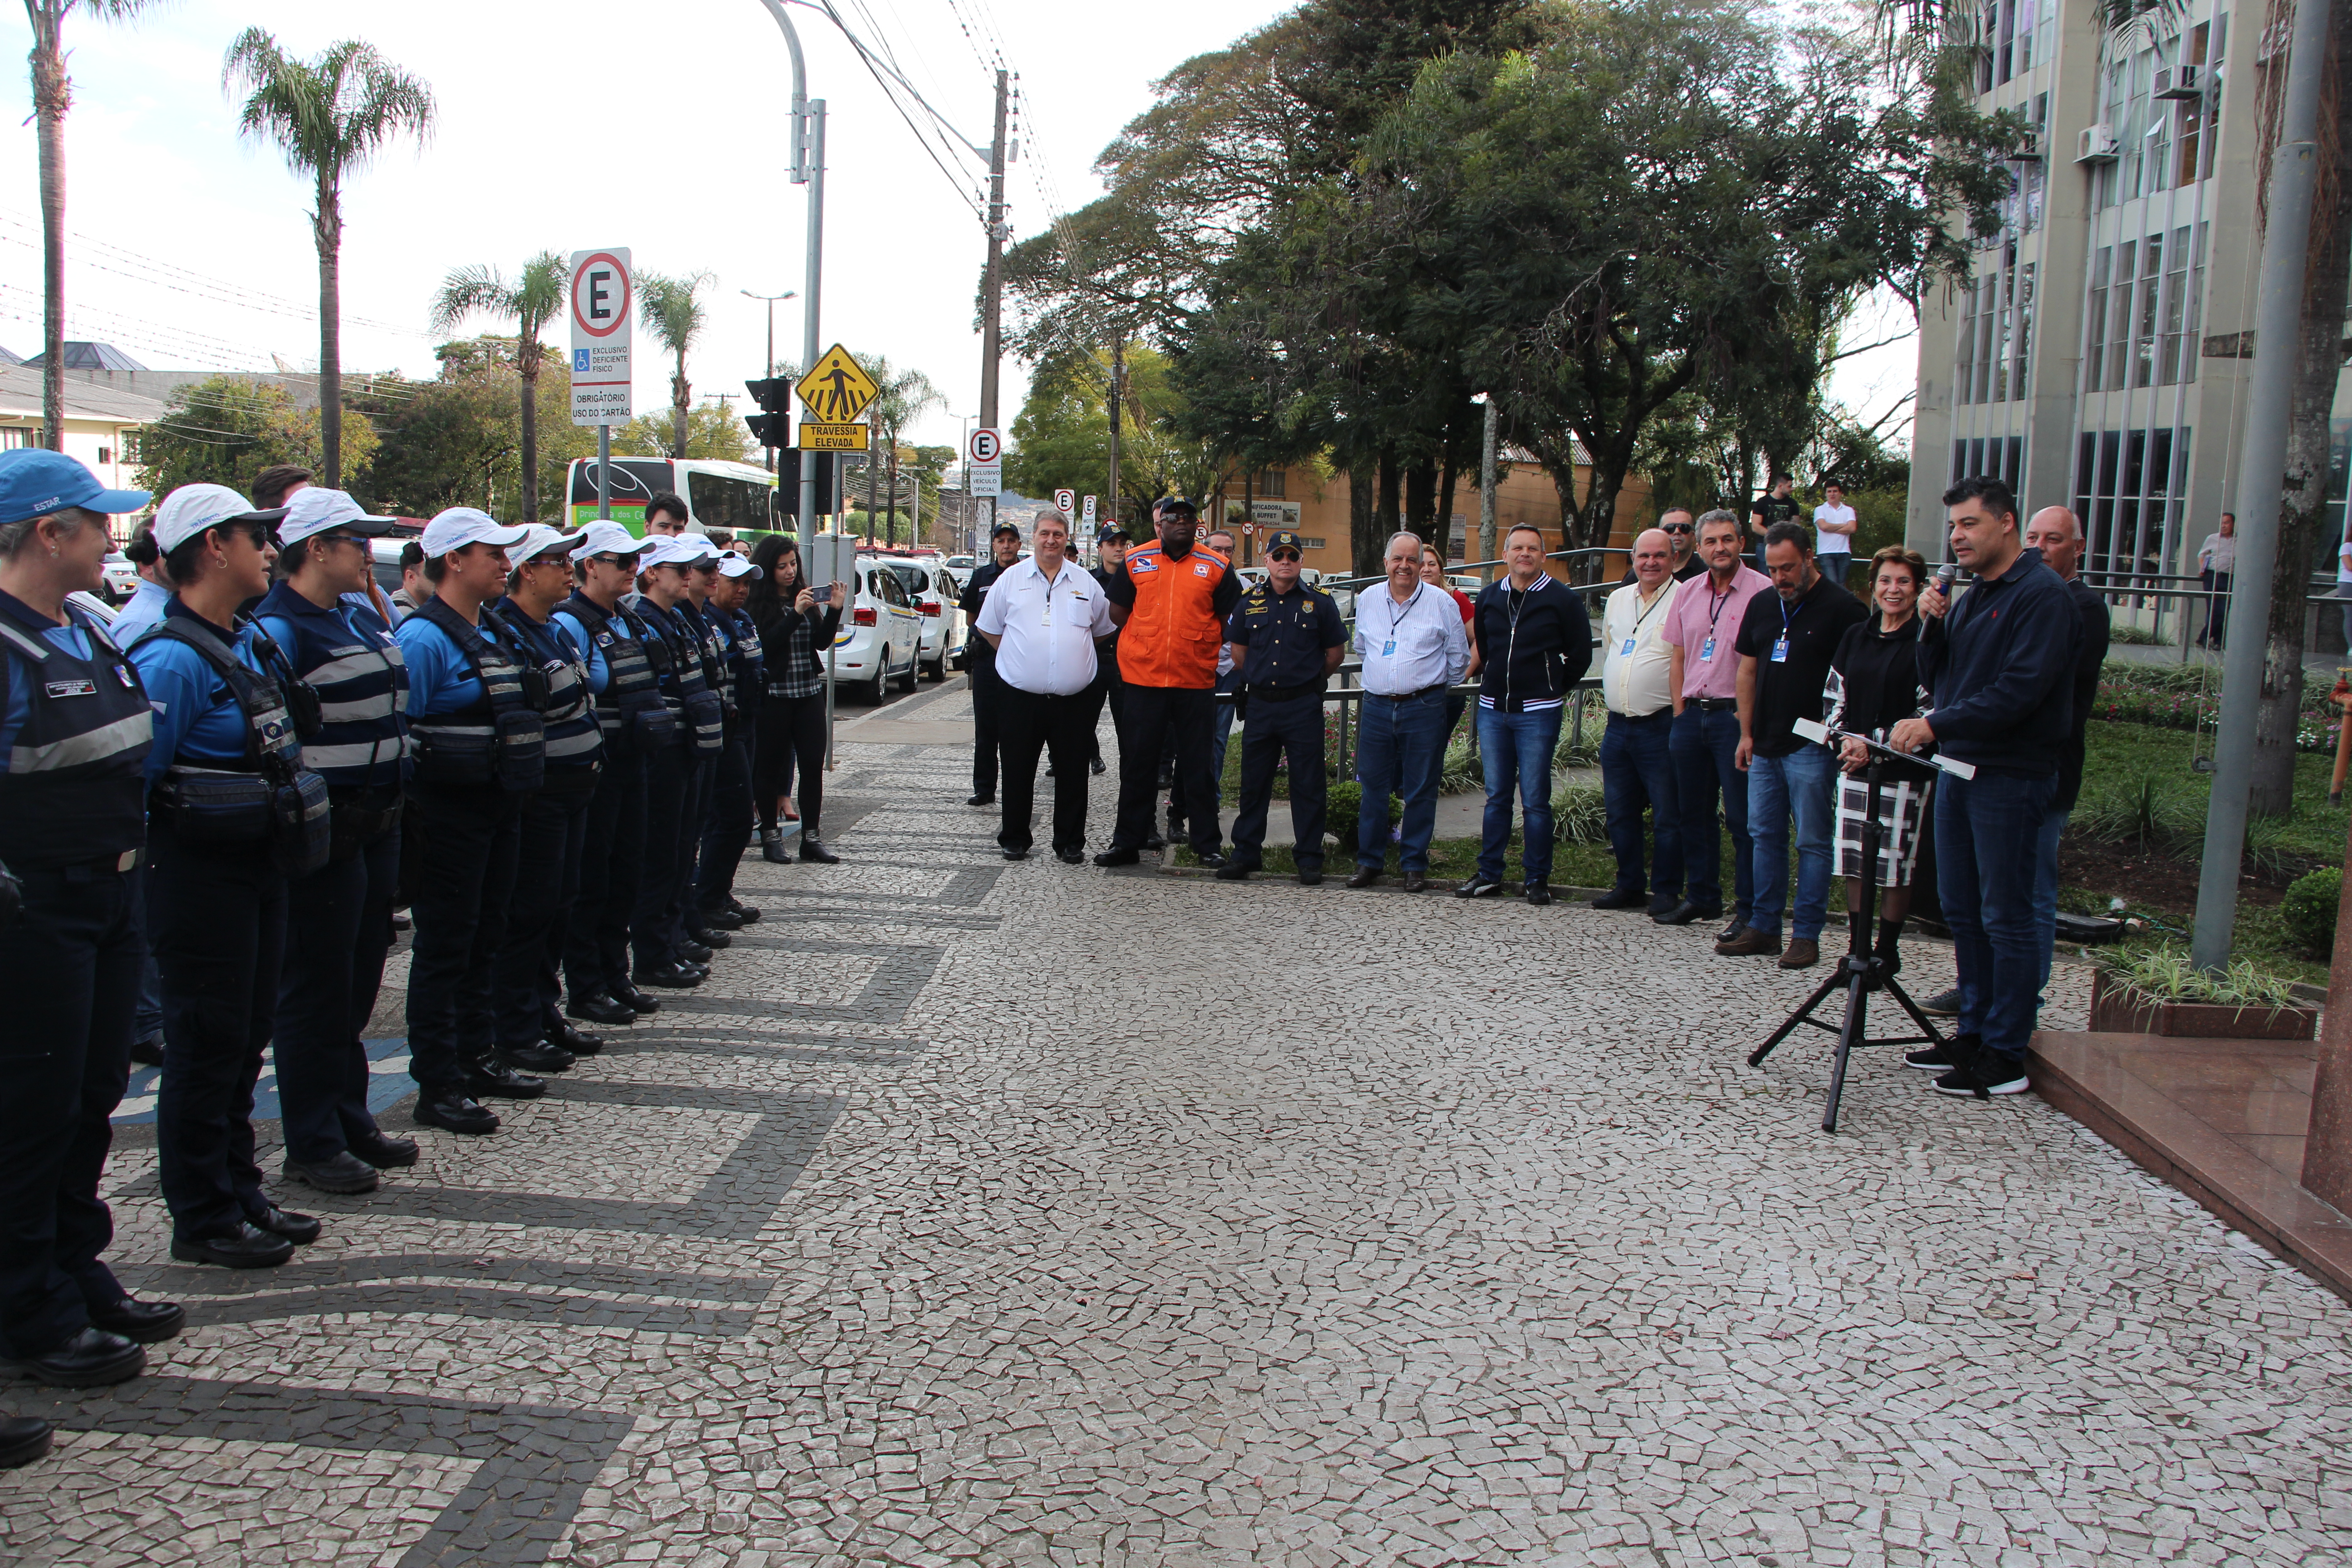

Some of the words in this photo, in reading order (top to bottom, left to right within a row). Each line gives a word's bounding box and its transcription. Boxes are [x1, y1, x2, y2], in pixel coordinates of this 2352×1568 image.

[590, 271, 610, 319] E
[593, 346, 627, 354] EXCLUSIVO
[593, 355, 628, 363] DEFICIENTE
[593, 364, 612, 372] FÍSICO
[577, 392, 625, 403] OBRIGATÓRIO
[573, 409, 587, 417] USO
[601, 407, 631, 416] CARTÃO
[811, 426, 858, 435] TRAVESSIA
[815, 438, 853, 447] ELEVADA
[979, 436, 990, 455] E
[34, 496, 61, 512] ESTAR
[1061, 495, 1068, 507] E
[1087, 500, 1092, 511] E
[580, 510, 614, 518] Princa
[191, 513, 220, 529] TRÂNSITO
[304, 516, 330, 530] TRÂNSITO
[446, 533, 468, 545] TRÂNSITO
